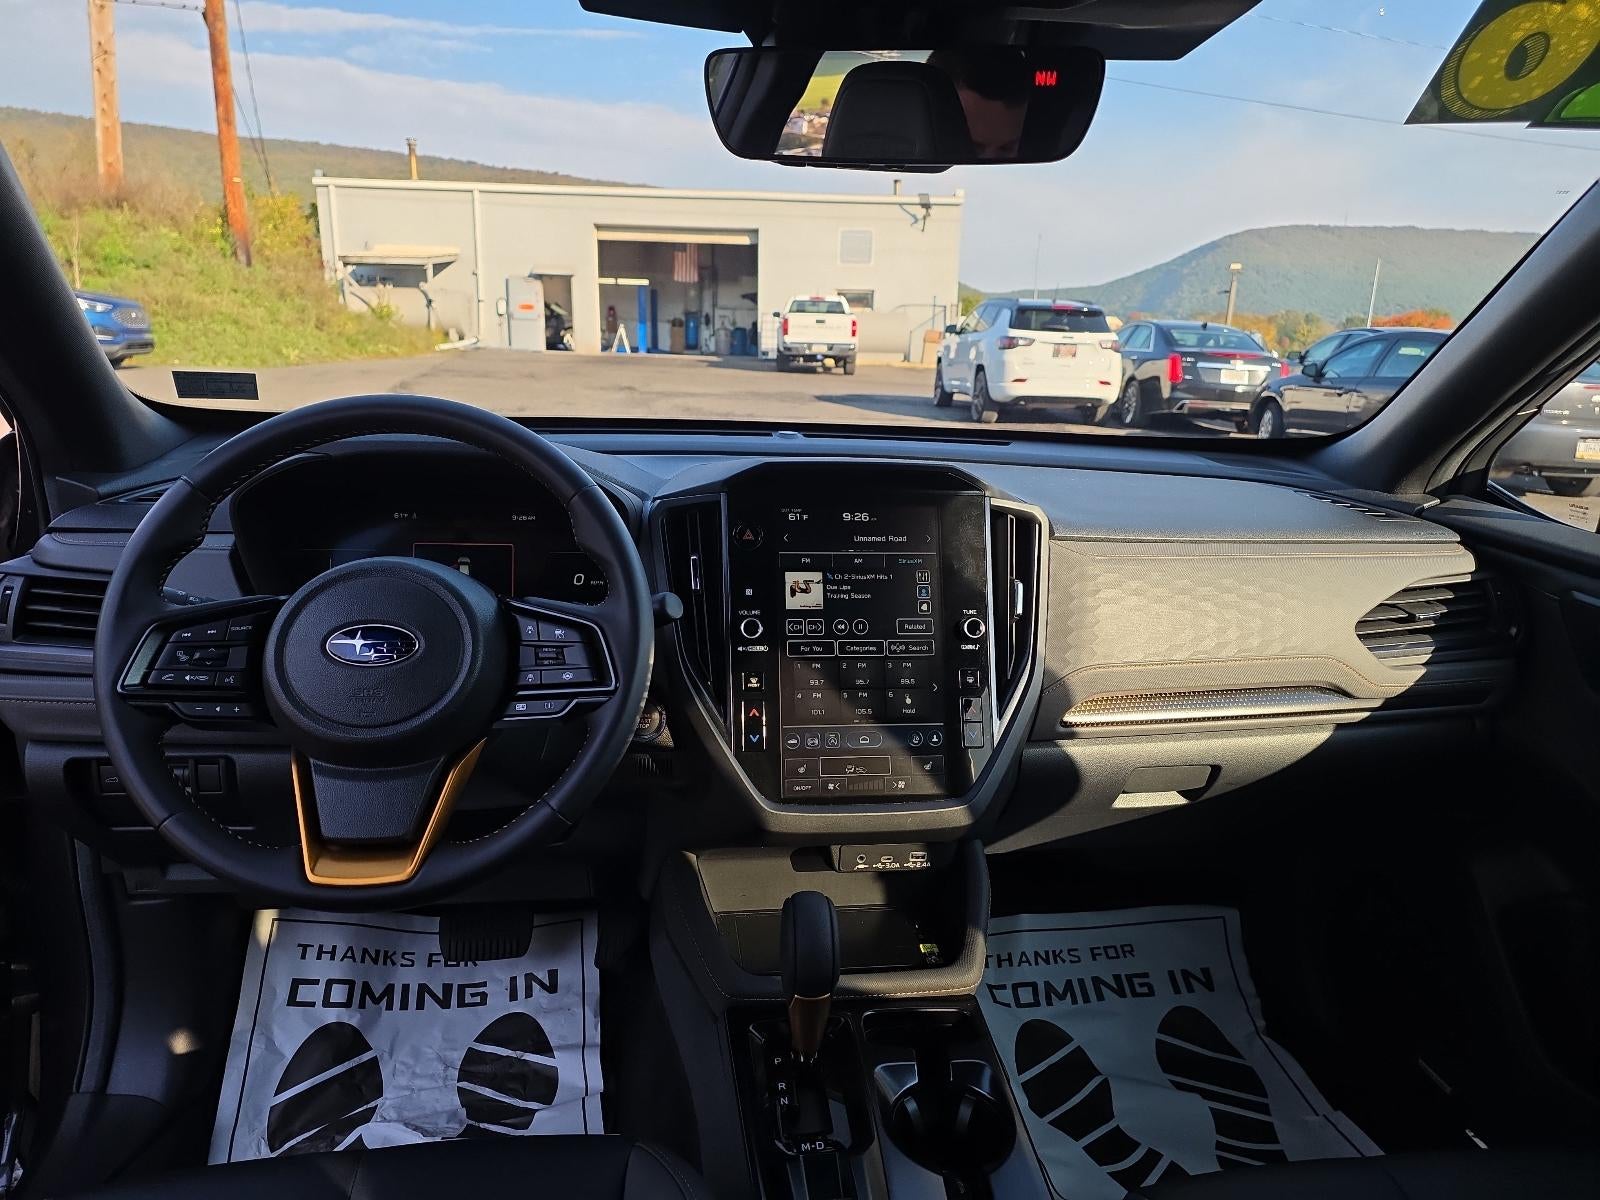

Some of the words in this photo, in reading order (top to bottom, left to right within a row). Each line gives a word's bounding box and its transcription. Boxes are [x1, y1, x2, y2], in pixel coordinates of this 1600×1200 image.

[1035, 70, 1057, 86] NW
[842, 512, 869, 522] 9:26
[846, 645, 877, 653] Categories
[297, 943, 416, 967] THANKS
[985, 948, 1081, 969] THANKS
[1090, 943, 1136, 962] FOR
[286, 977, 488, 1011] COMING
[508, 969, 559, 1003] IN
[986, 971, 1156, 1009] COMING
[1167, 967, 1216, 996] IN
[774, 1057, 782, 1065] P
[778, 1082, 787, 1091] R
[780, 1096, 789, 1105] N
